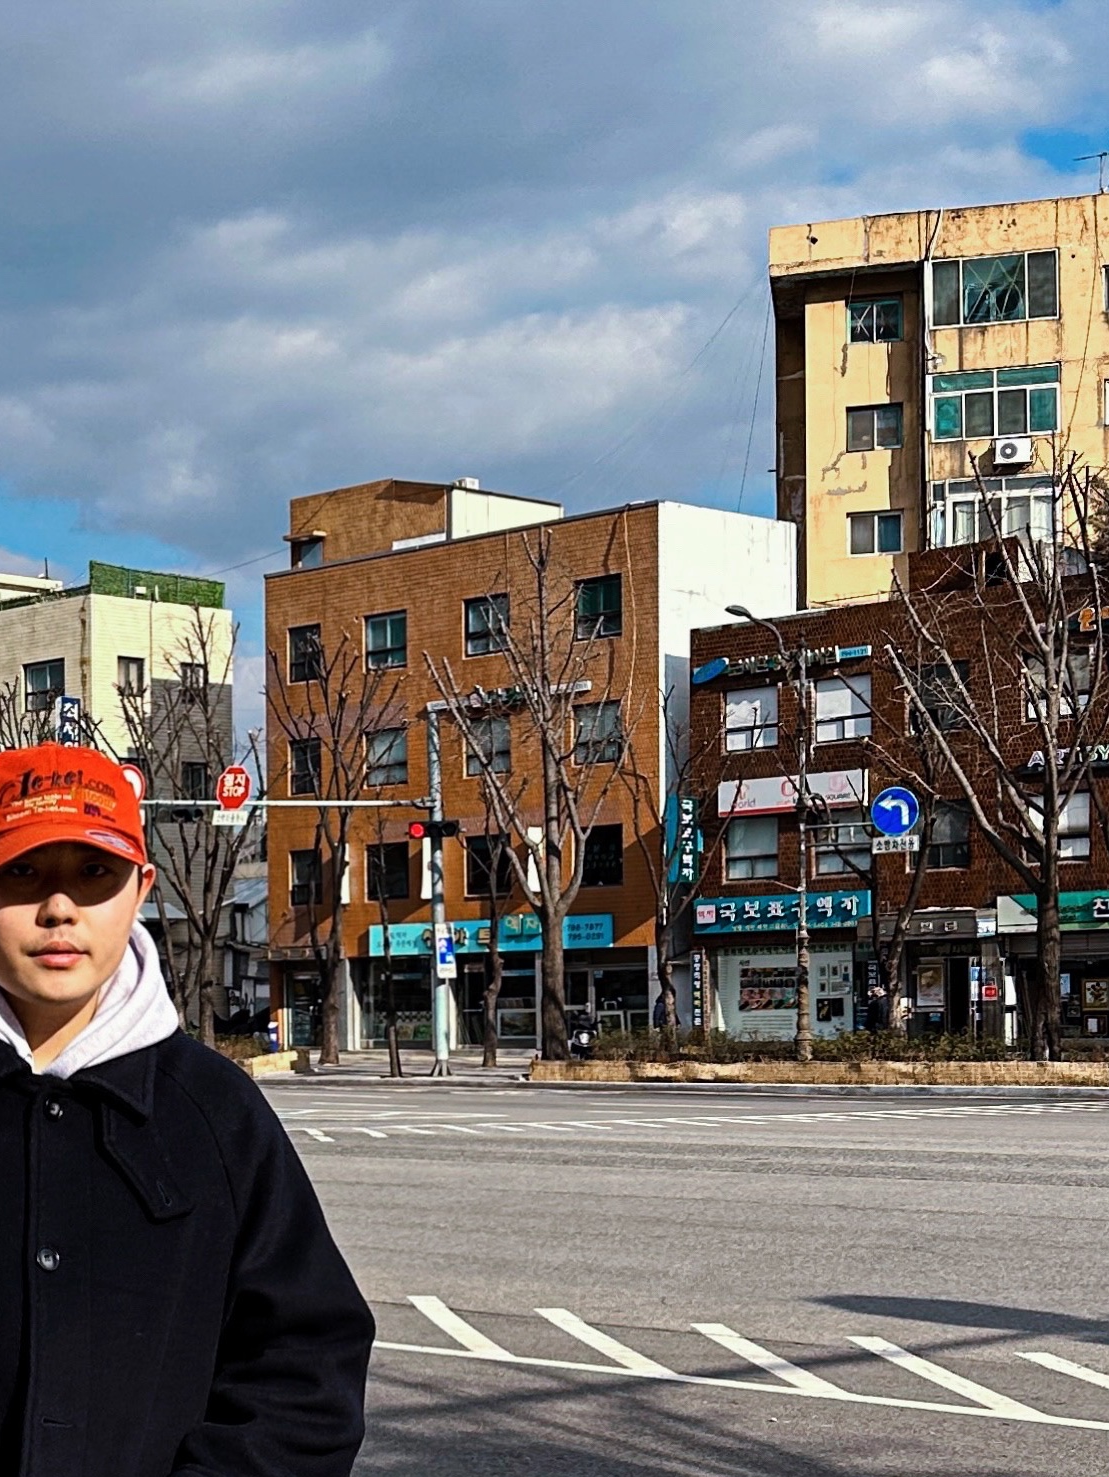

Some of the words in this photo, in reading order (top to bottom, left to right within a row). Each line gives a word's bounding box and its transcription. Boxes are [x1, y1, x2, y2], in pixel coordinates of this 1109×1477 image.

[223, 773, 246, 787] 정지
[222, 786, 245, 797] STOP
[876, 837, 916, 851] 소방차전용
